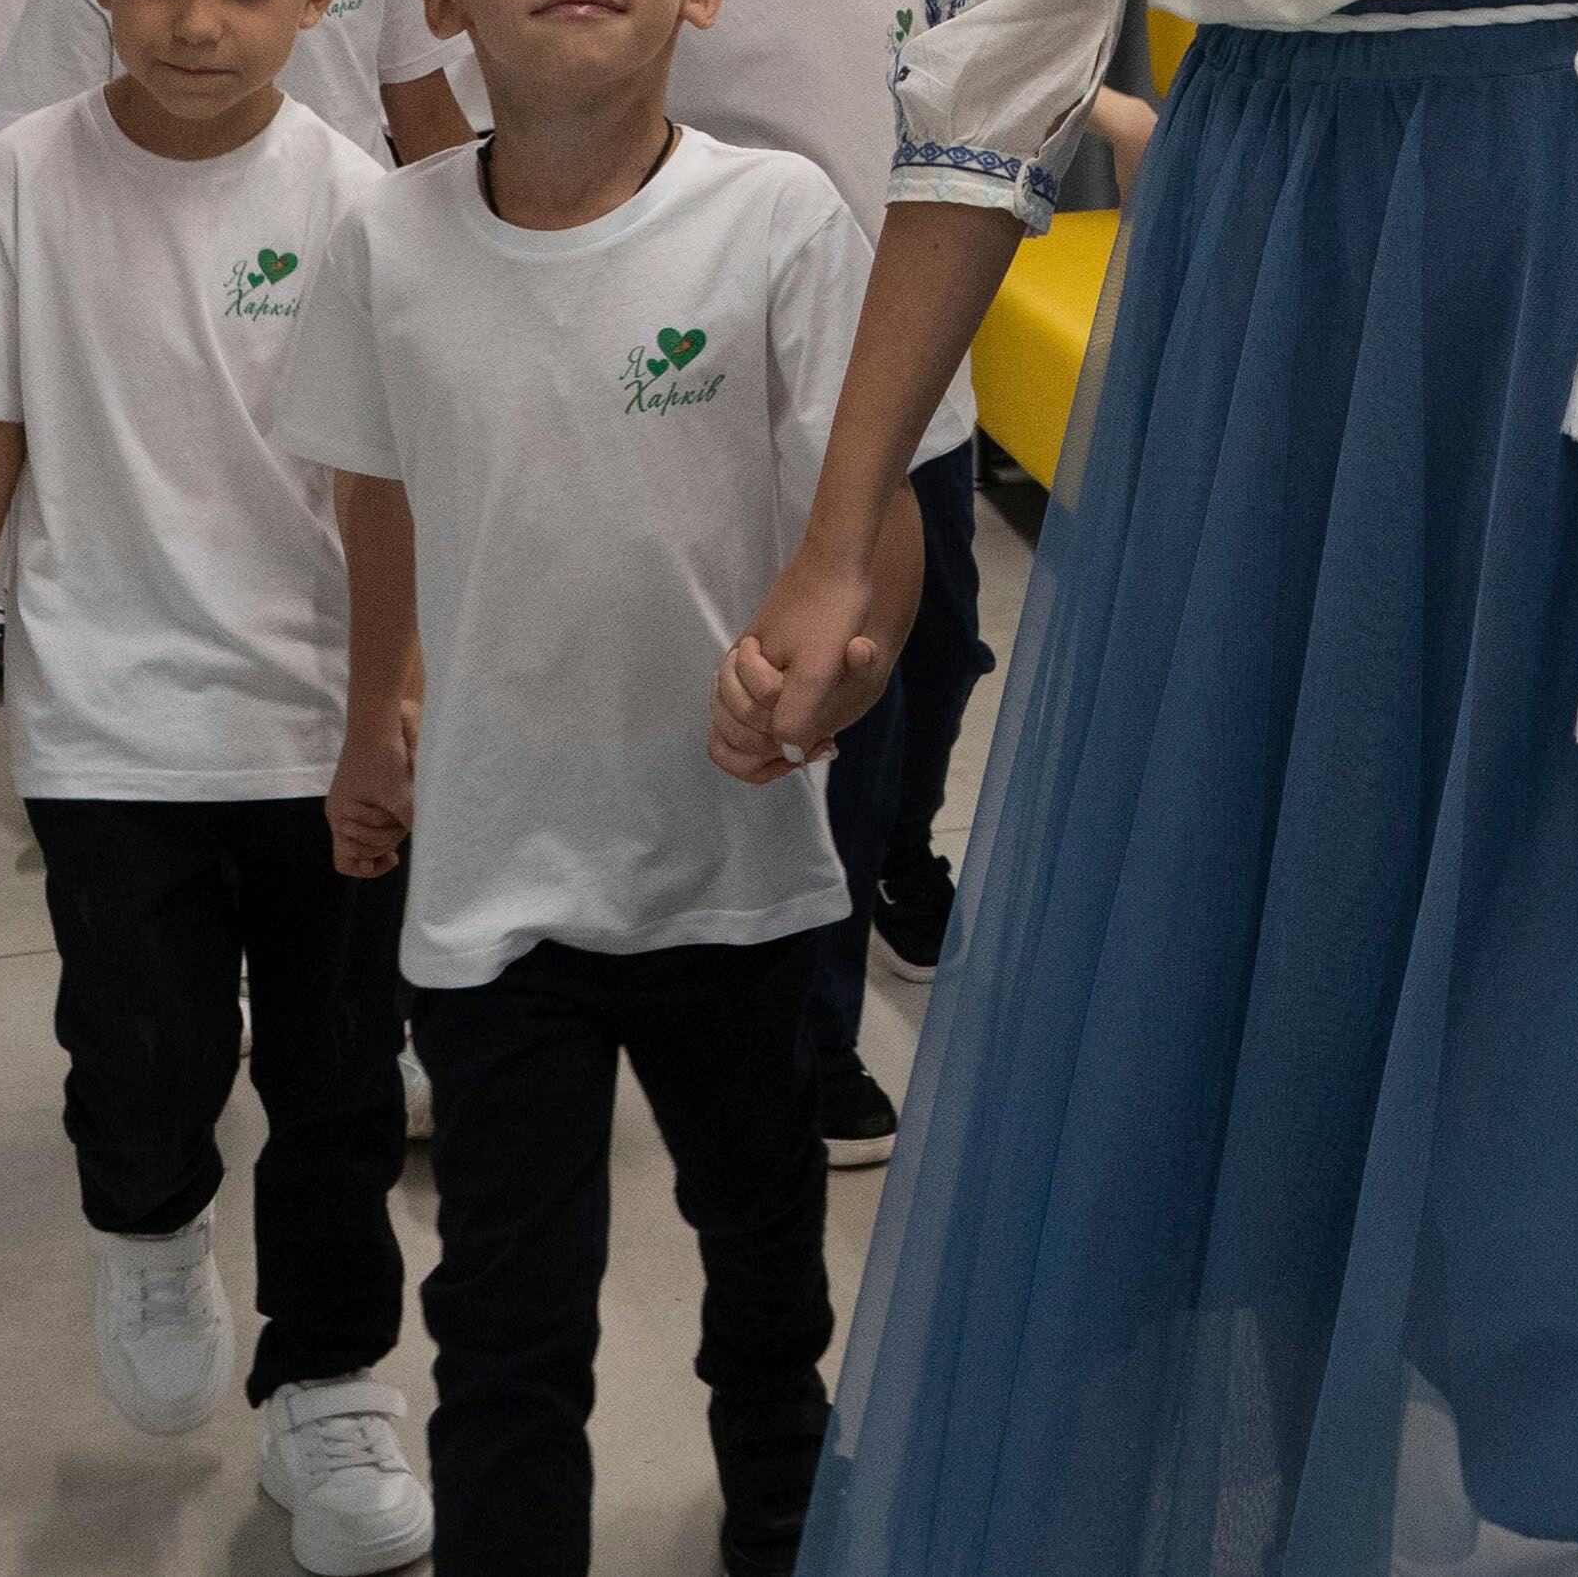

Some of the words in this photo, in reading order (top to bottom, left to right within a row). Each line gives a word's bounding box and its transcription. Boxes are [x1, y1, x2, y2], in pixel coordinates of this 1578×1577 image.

[223, 260, 248, 288] Я
[619, 345, 648, 380] Я
[624, 374, 725, 416] Харків
